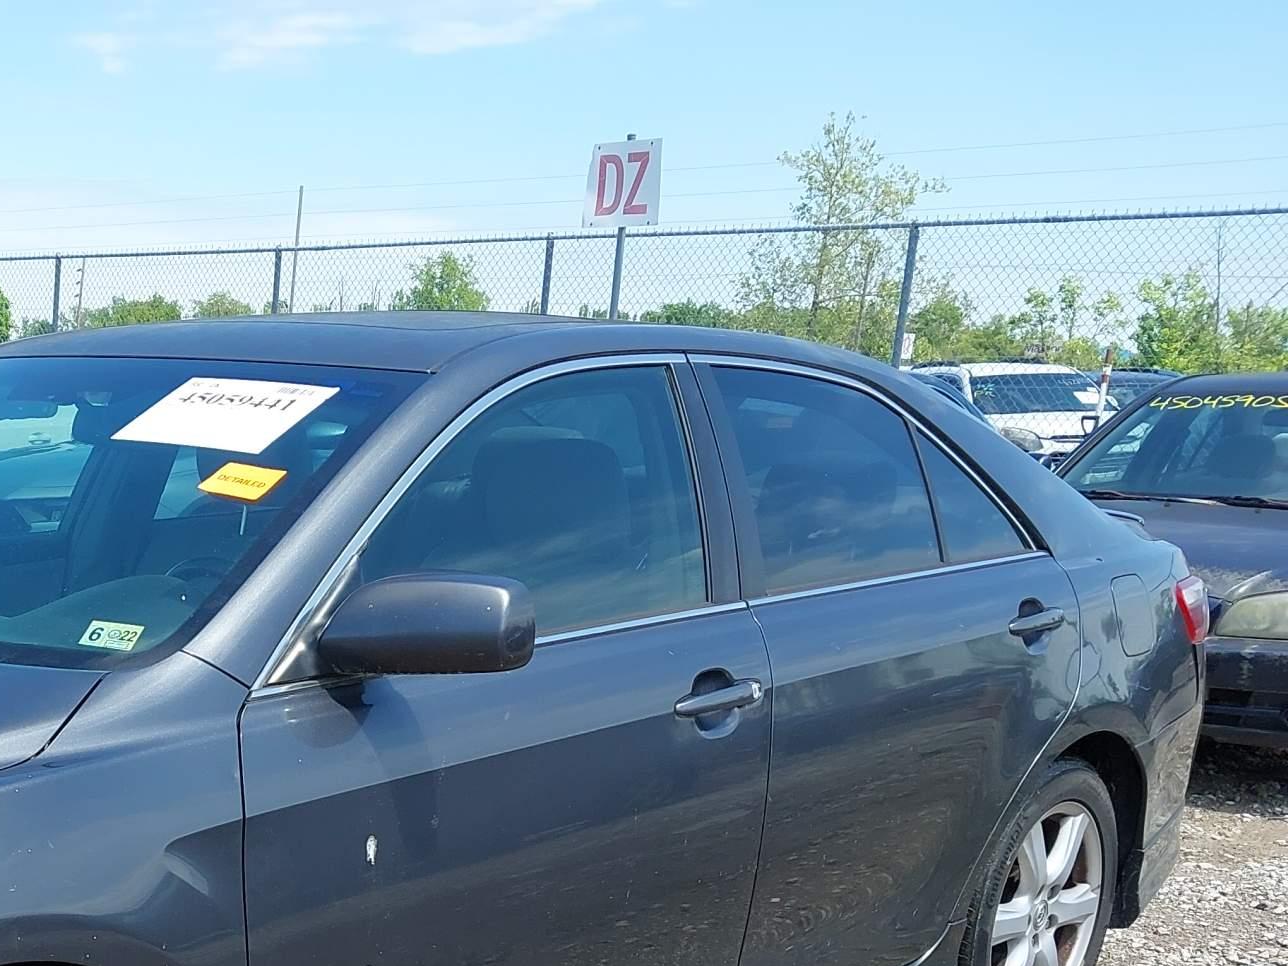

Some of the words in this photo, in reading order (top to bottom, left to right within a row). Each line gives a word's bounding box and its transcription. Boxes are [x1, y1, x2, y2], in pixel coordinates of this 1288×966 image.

[594, 151, 649, 216] DZ
[179, 391, 297, 411] 45059441
[216, 474, 266, 489] DETAILED
[88, 627, 105, 641] 6
[118, 630, 138, 642] 22
